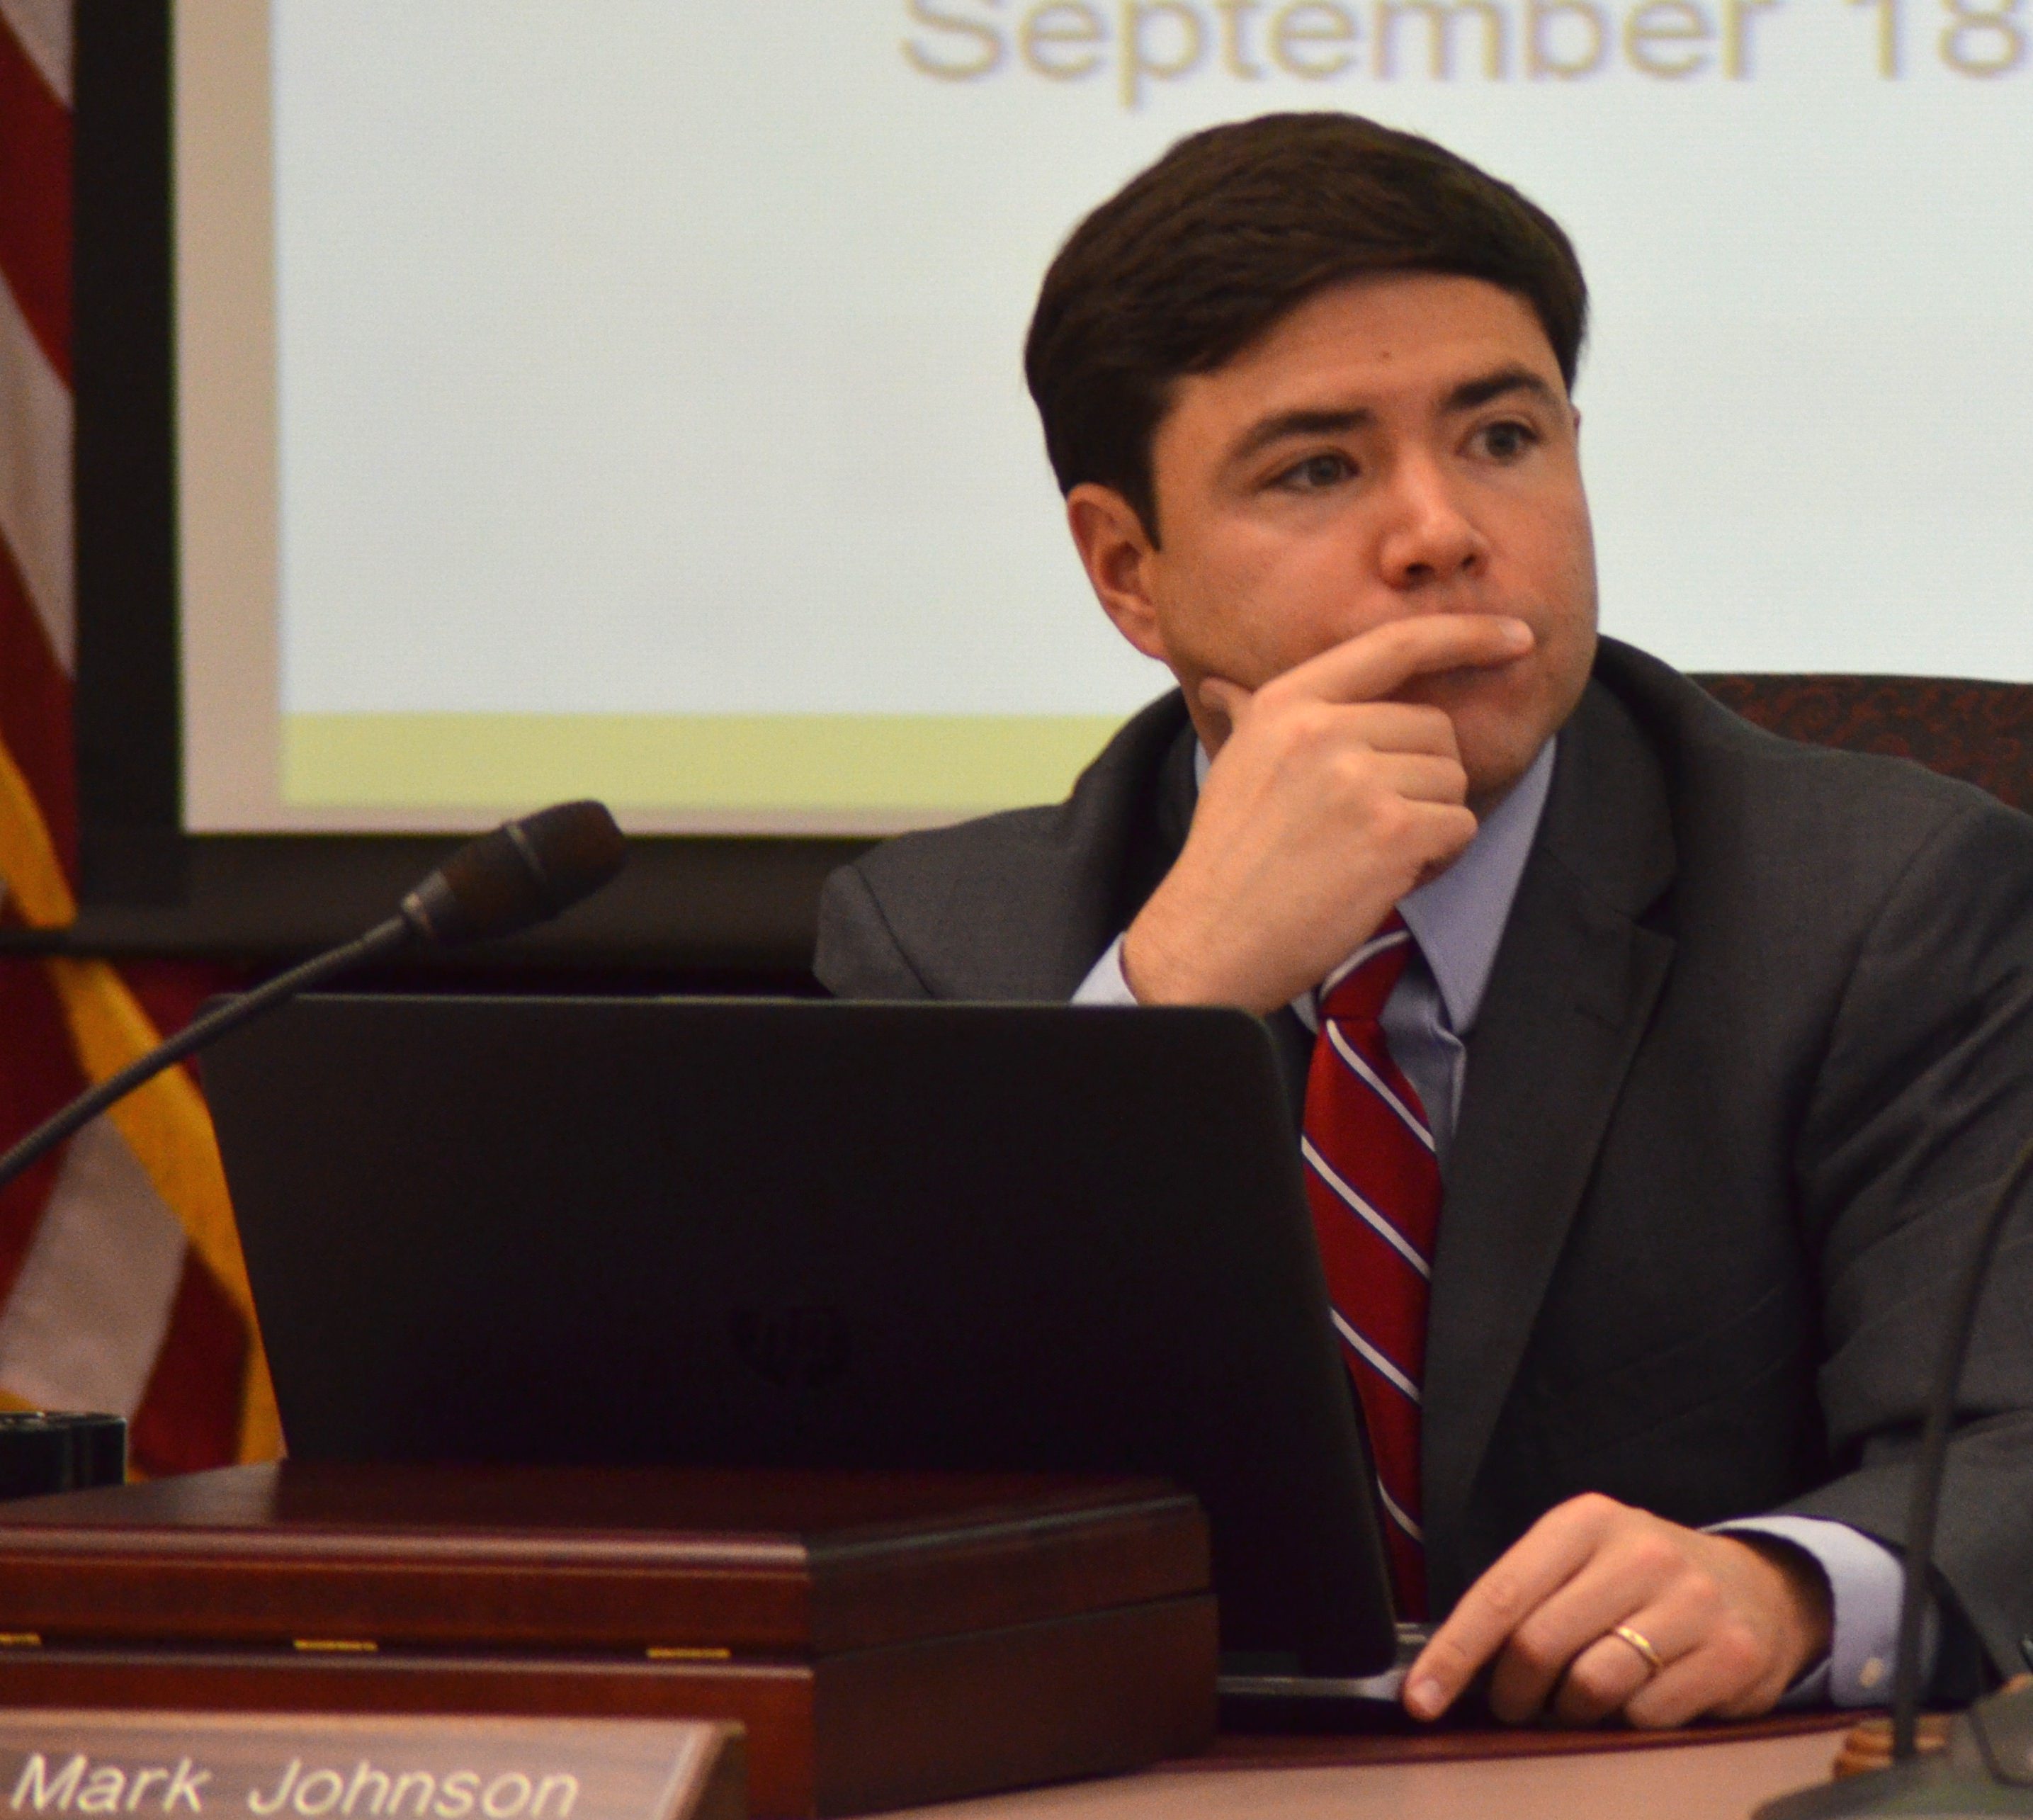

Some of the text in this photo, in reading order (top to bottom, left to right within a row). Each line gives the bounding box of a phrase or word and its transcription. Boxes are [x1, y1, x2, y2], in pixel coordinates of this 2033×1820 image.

[900, 0, 2026, 109] September 18
[9, 1753, 579, 1818] Mark Johnson
